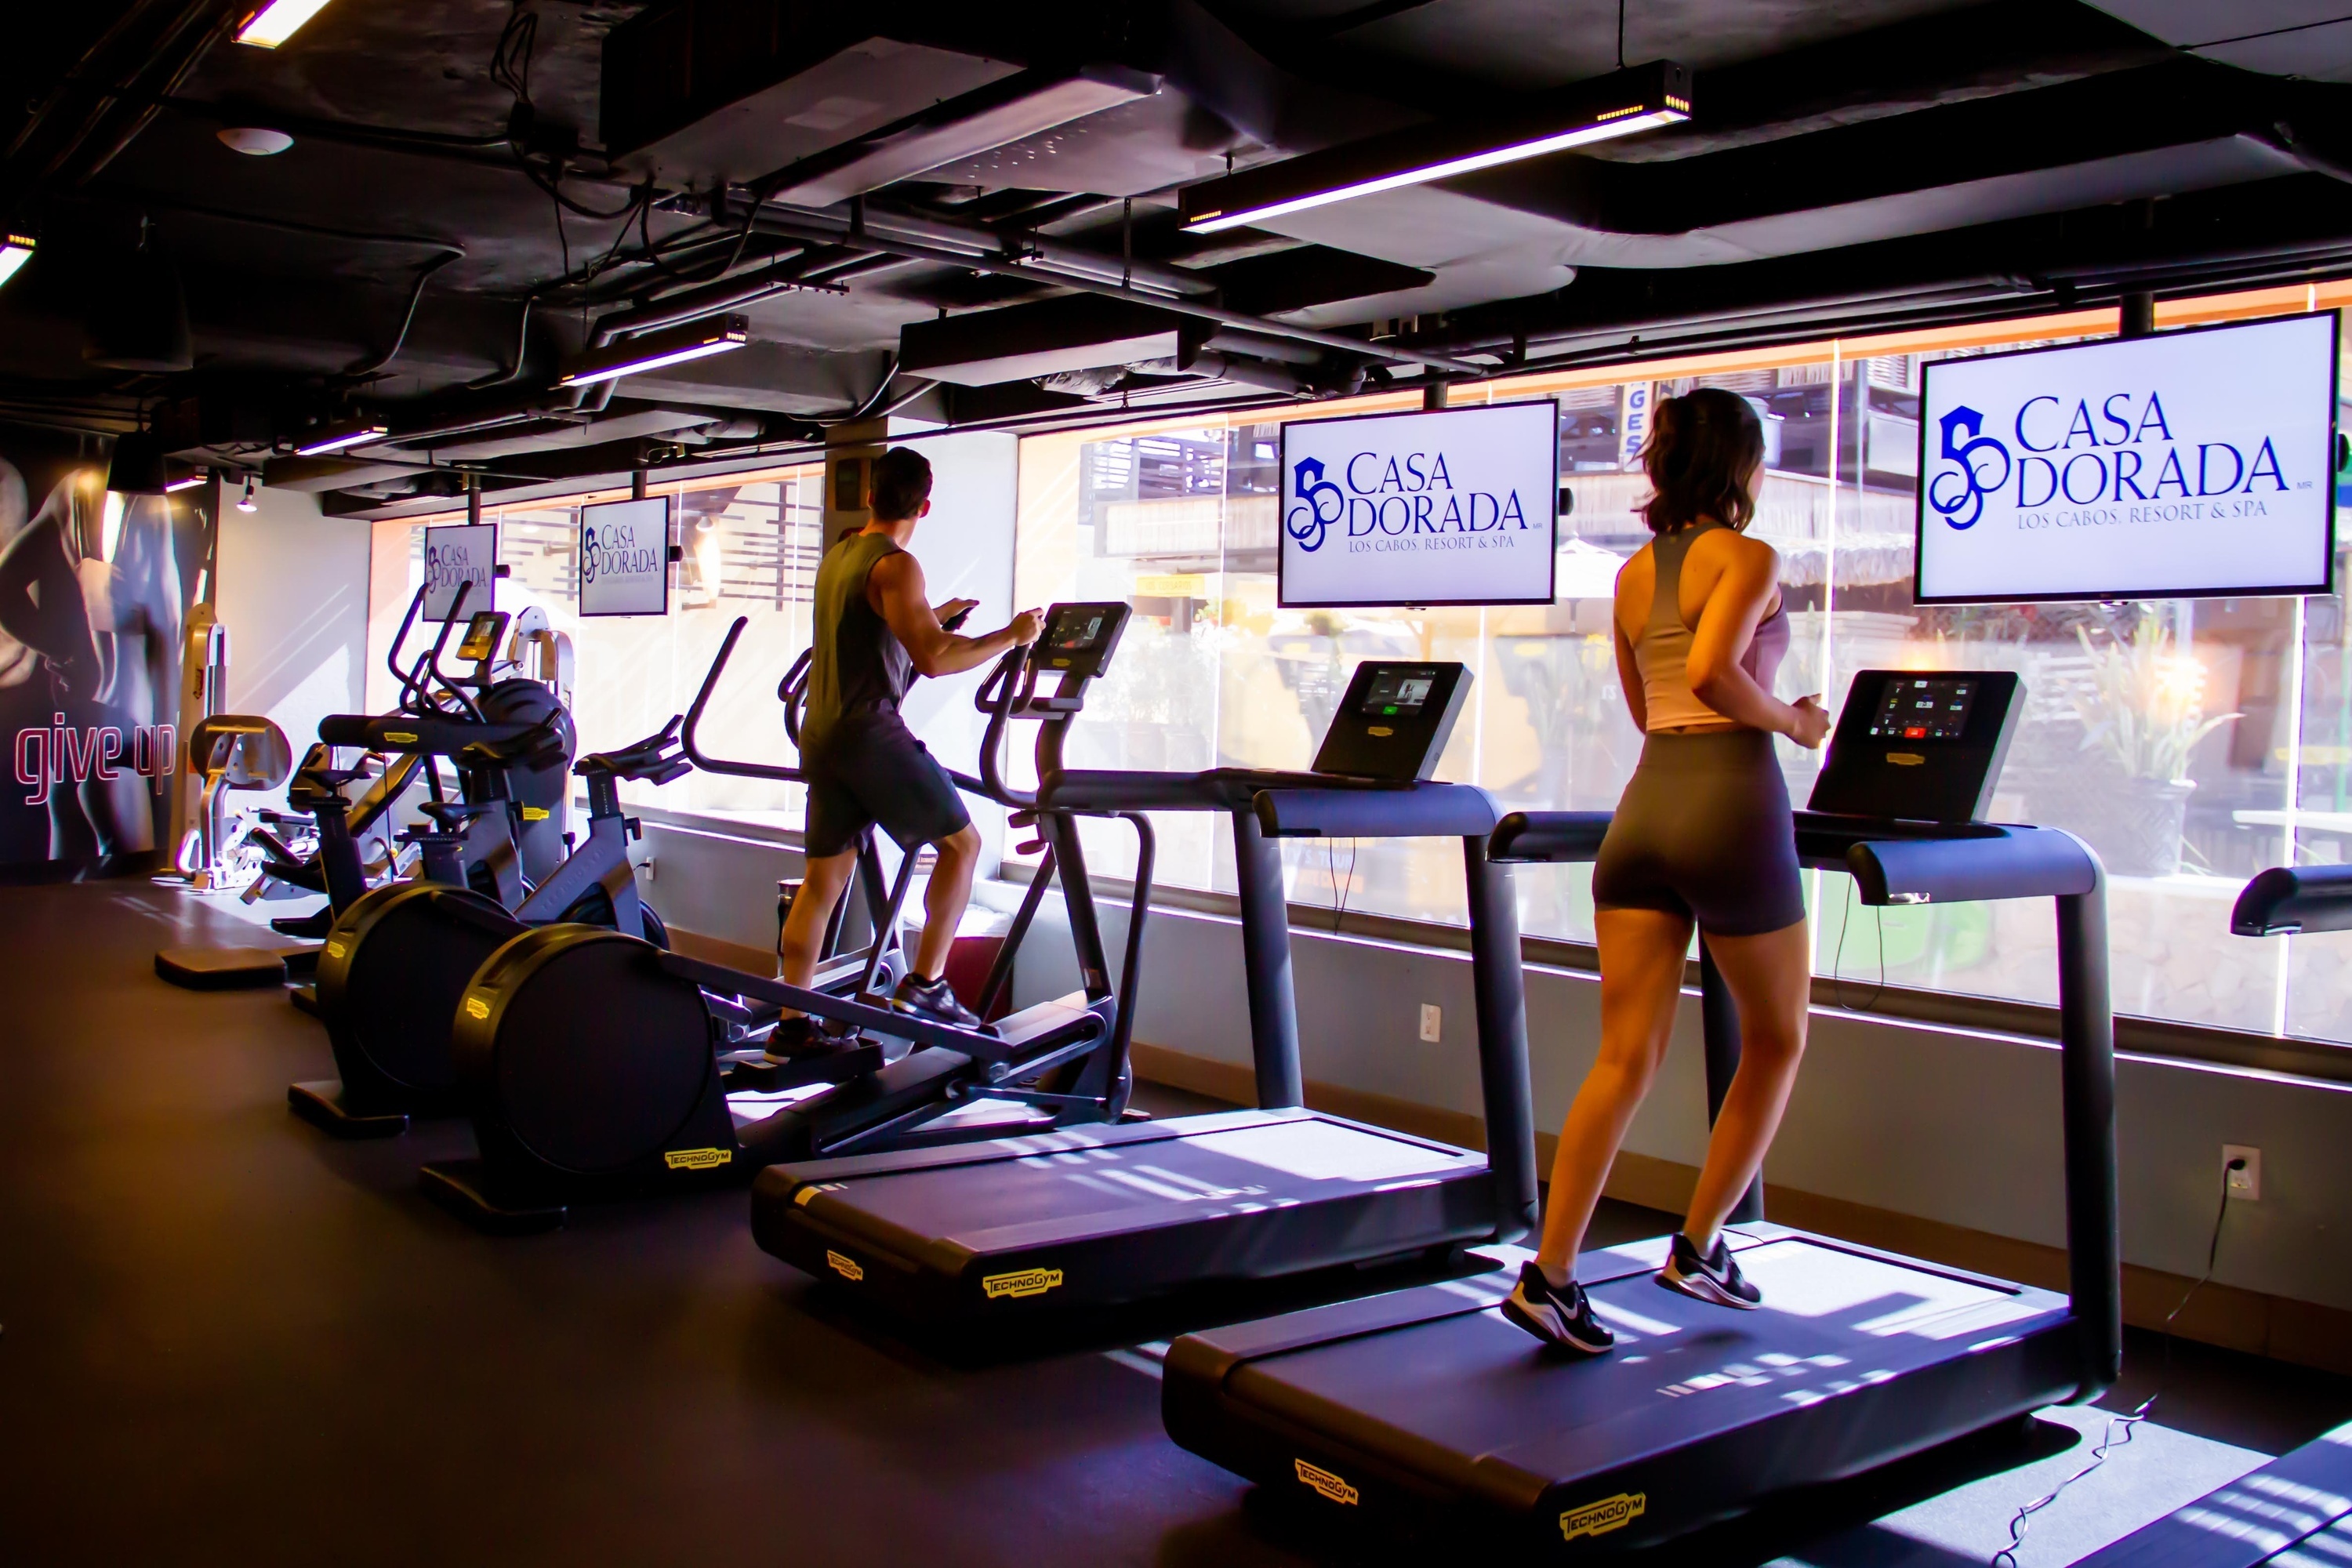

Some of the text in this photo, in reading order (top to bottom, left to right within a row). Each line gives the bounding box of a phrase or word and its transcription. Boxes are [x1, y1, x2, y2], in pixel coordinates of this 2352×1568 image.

[1625, 382, 1646, 454] GES
[2015, 390, 2174, 452] CASA
[1347, 452, 1454, 495] CASA
[2016, 435, 2290, 509] DORADA
[1347, 488, 1528, 537] DORADA
[2017, 512, 2049, 529] LOS
[2129, 503, 2205, 524] RESORT
[2210, 502, 2226, 518] &
[2232, 499, 2268, 517] SPA
[441, 544, 469, 566] CASA
[601, 524, 635, 550] CASA
[1348, 541, 1371, 553] LOS
[1425, 536, 1475, 550] RESORT
[1478, 535, 1488, 549] &
[1491, 535, 1515, 548] SPA
[601, 547, 658, 575] DORADA
[16, 712, 176, 805] give up
